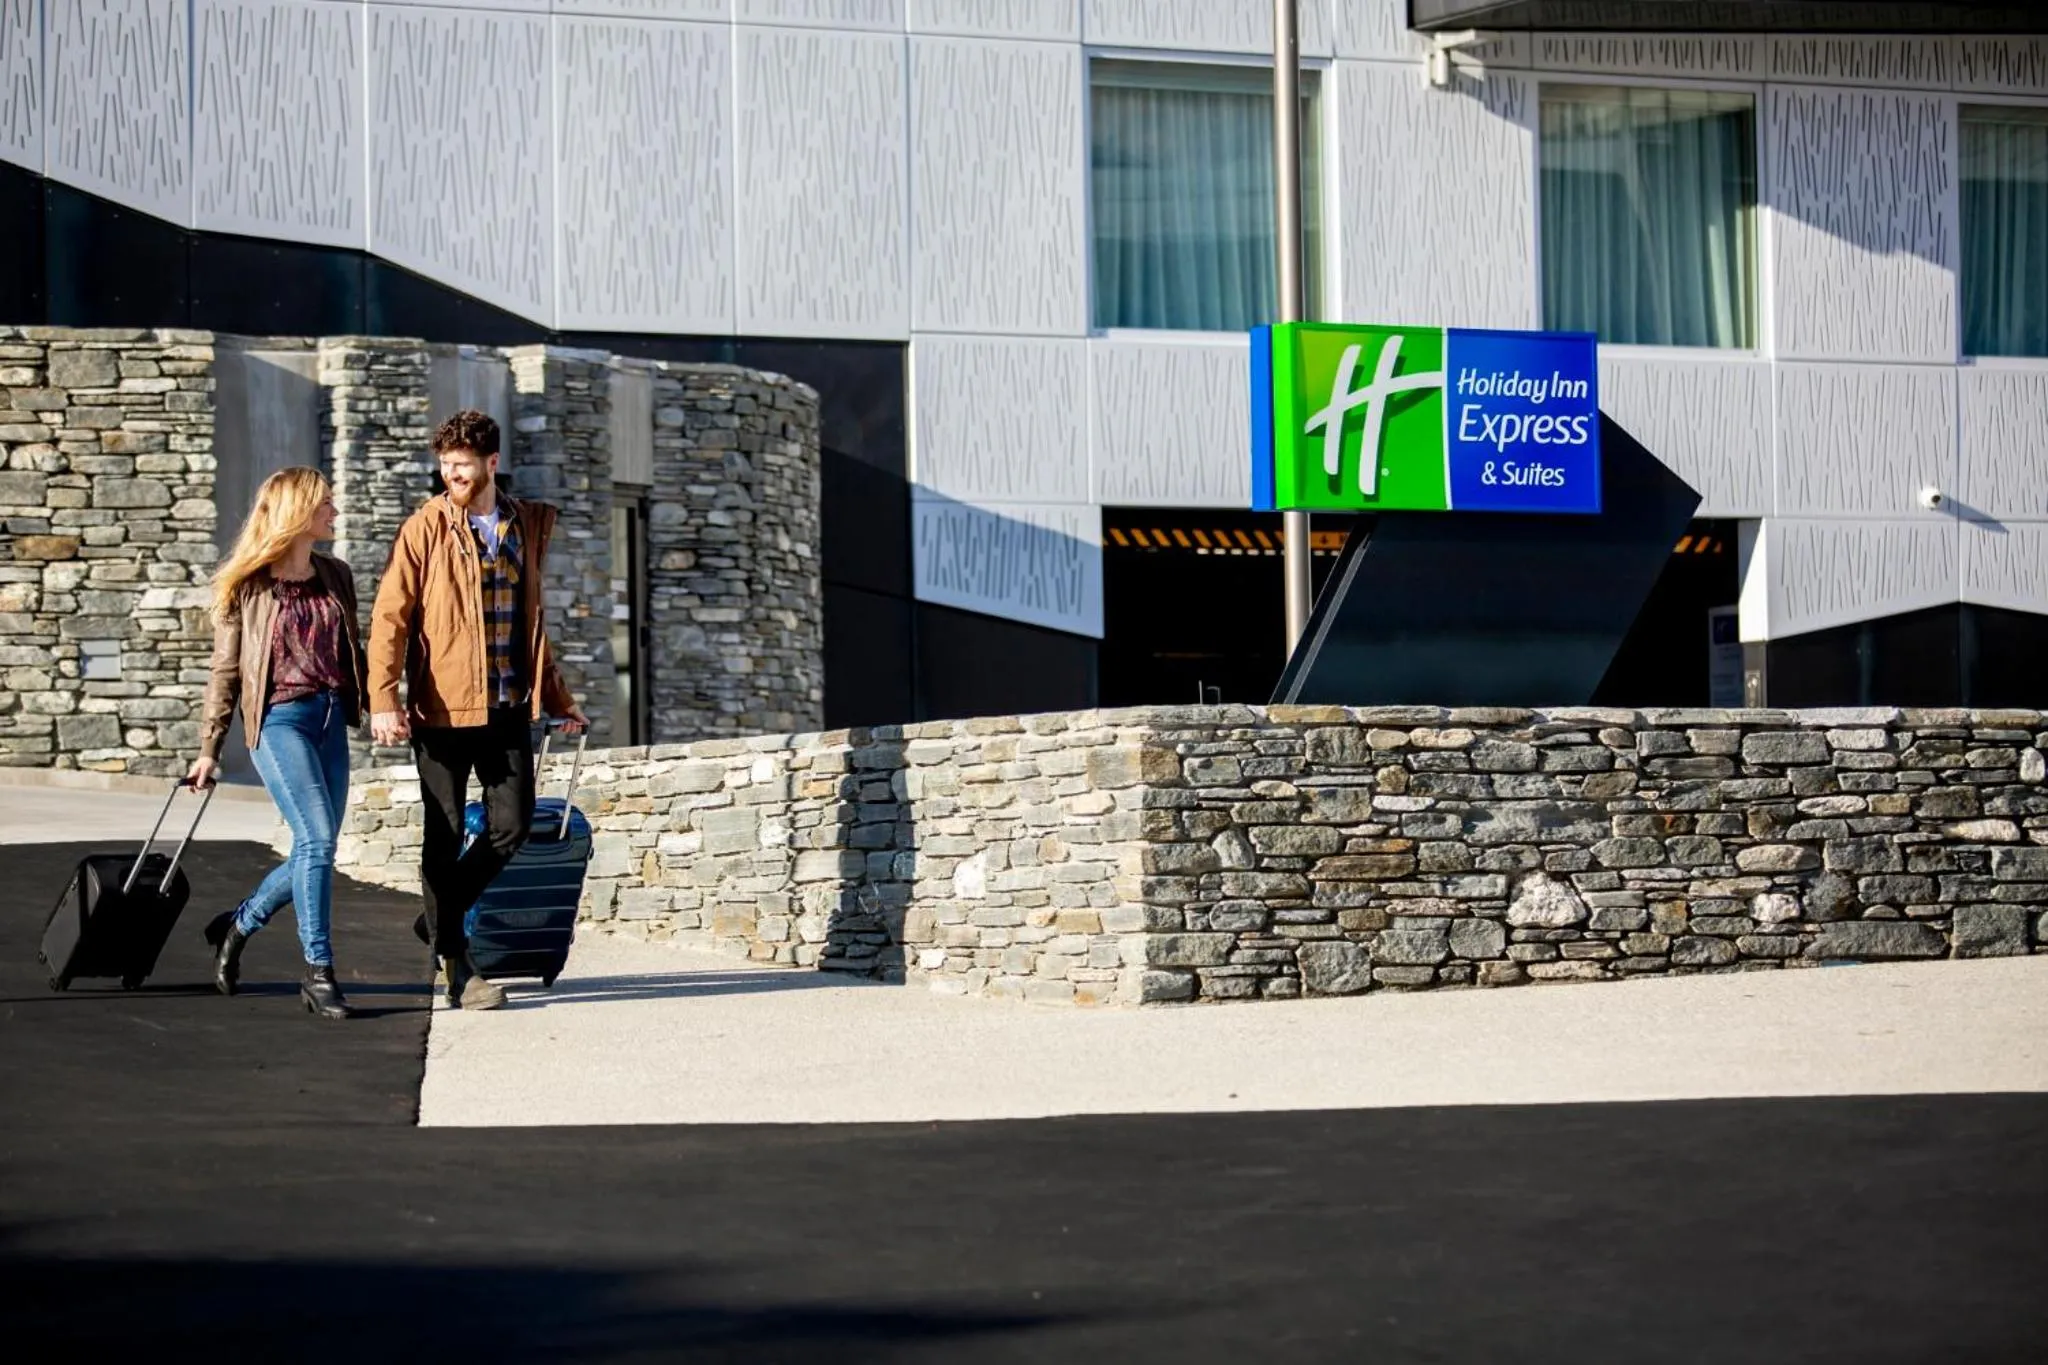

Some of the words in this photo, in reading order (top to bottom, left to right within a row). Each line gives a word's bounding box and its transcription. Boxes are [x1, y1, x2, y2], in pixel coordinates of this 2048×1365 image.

[1457, 367, 1548, 404] Holiday
[1551, 370, 1588, 399] Inn
[1458, 403, 1589, 453] Express
[1481, 460, 1497, 485] &
[1501, 461, 1565, 487] Suites
